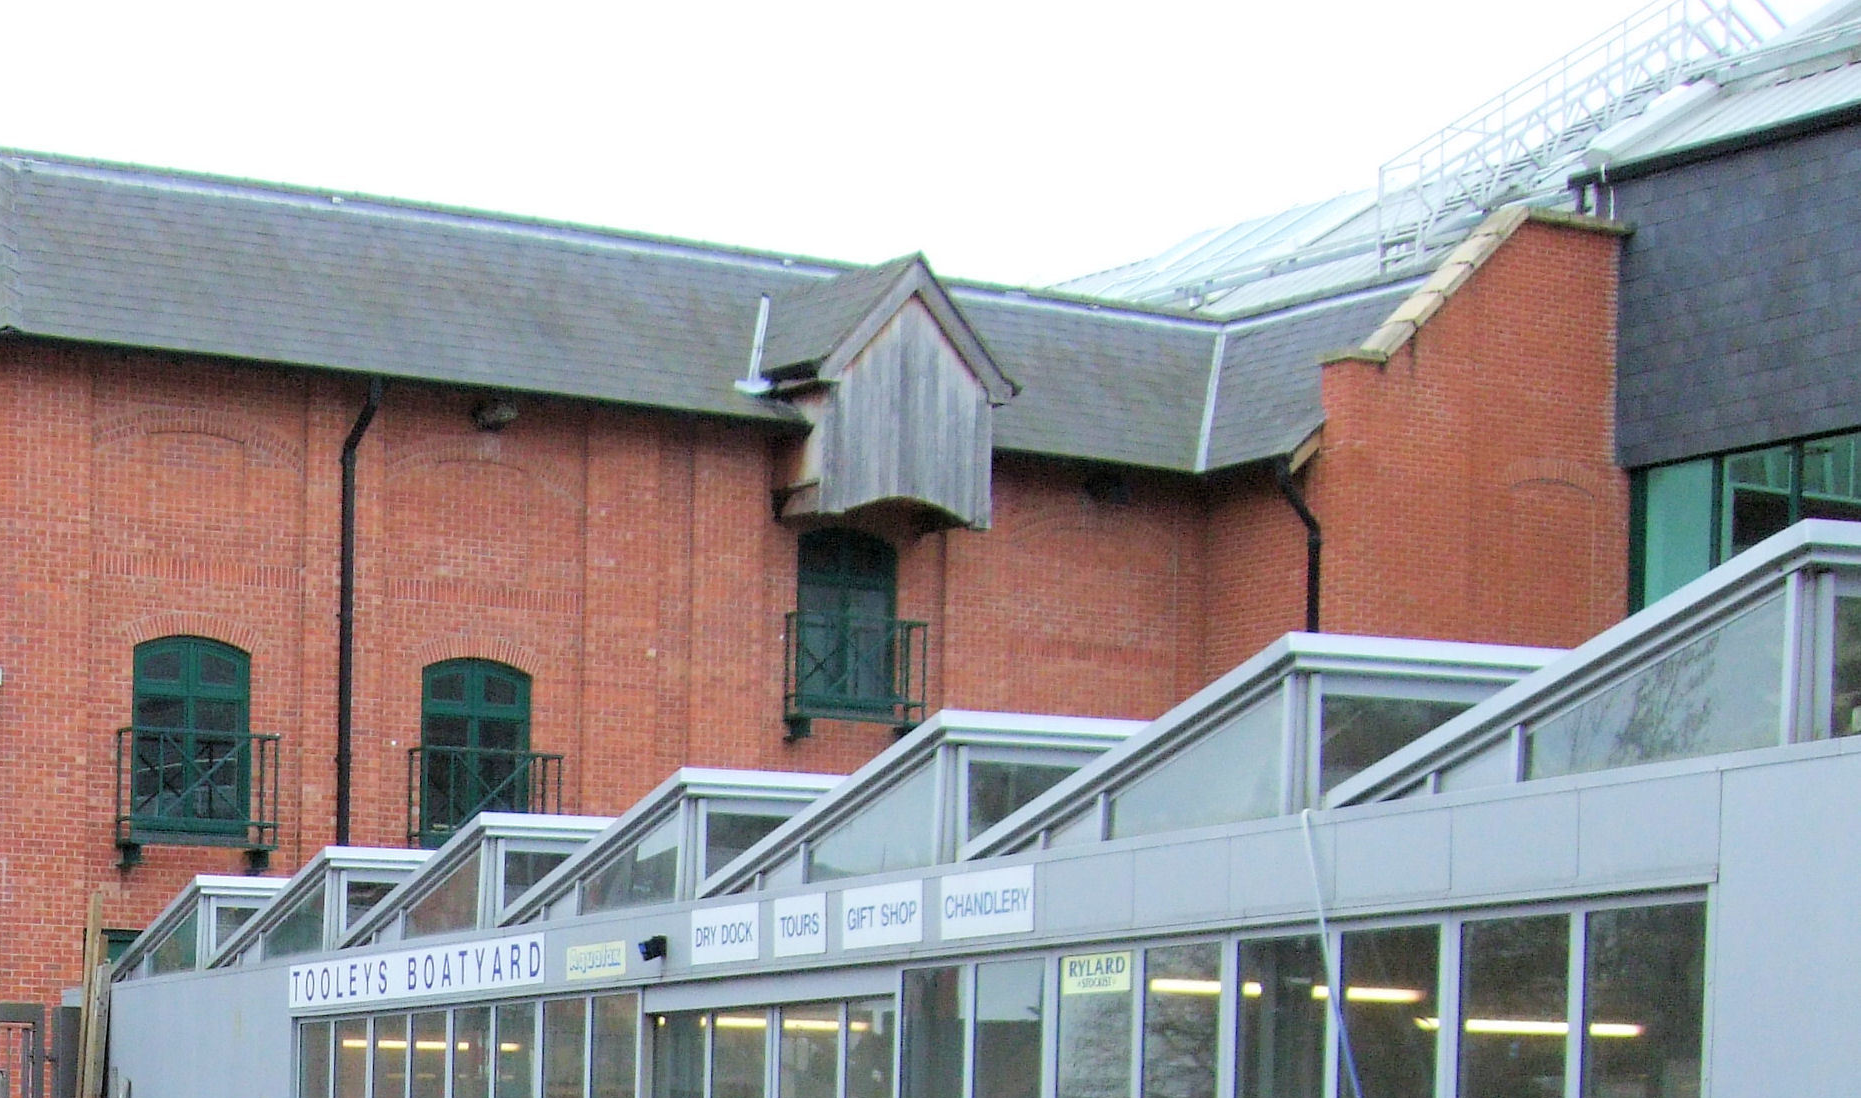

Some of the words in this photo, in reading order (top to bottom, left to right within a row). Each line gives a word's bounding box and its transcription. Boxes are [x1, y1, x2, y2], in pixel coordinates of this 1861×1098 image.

[847, 906, 876, 931] GIFT
[880, 901, 917, 927] SHOP
[944, 888, 1030, 919] CHANDLERY
[695, 926, 717, 948] DRY
[721, 921, 753, 945] DOCK
[780, 913, 820, 938] TOURS
[292, 959, 388, 1002] TOOLEYS
[407, 941, 541, 990] BOATYARD
[1069, 956, 1126, 978] RYLARD
